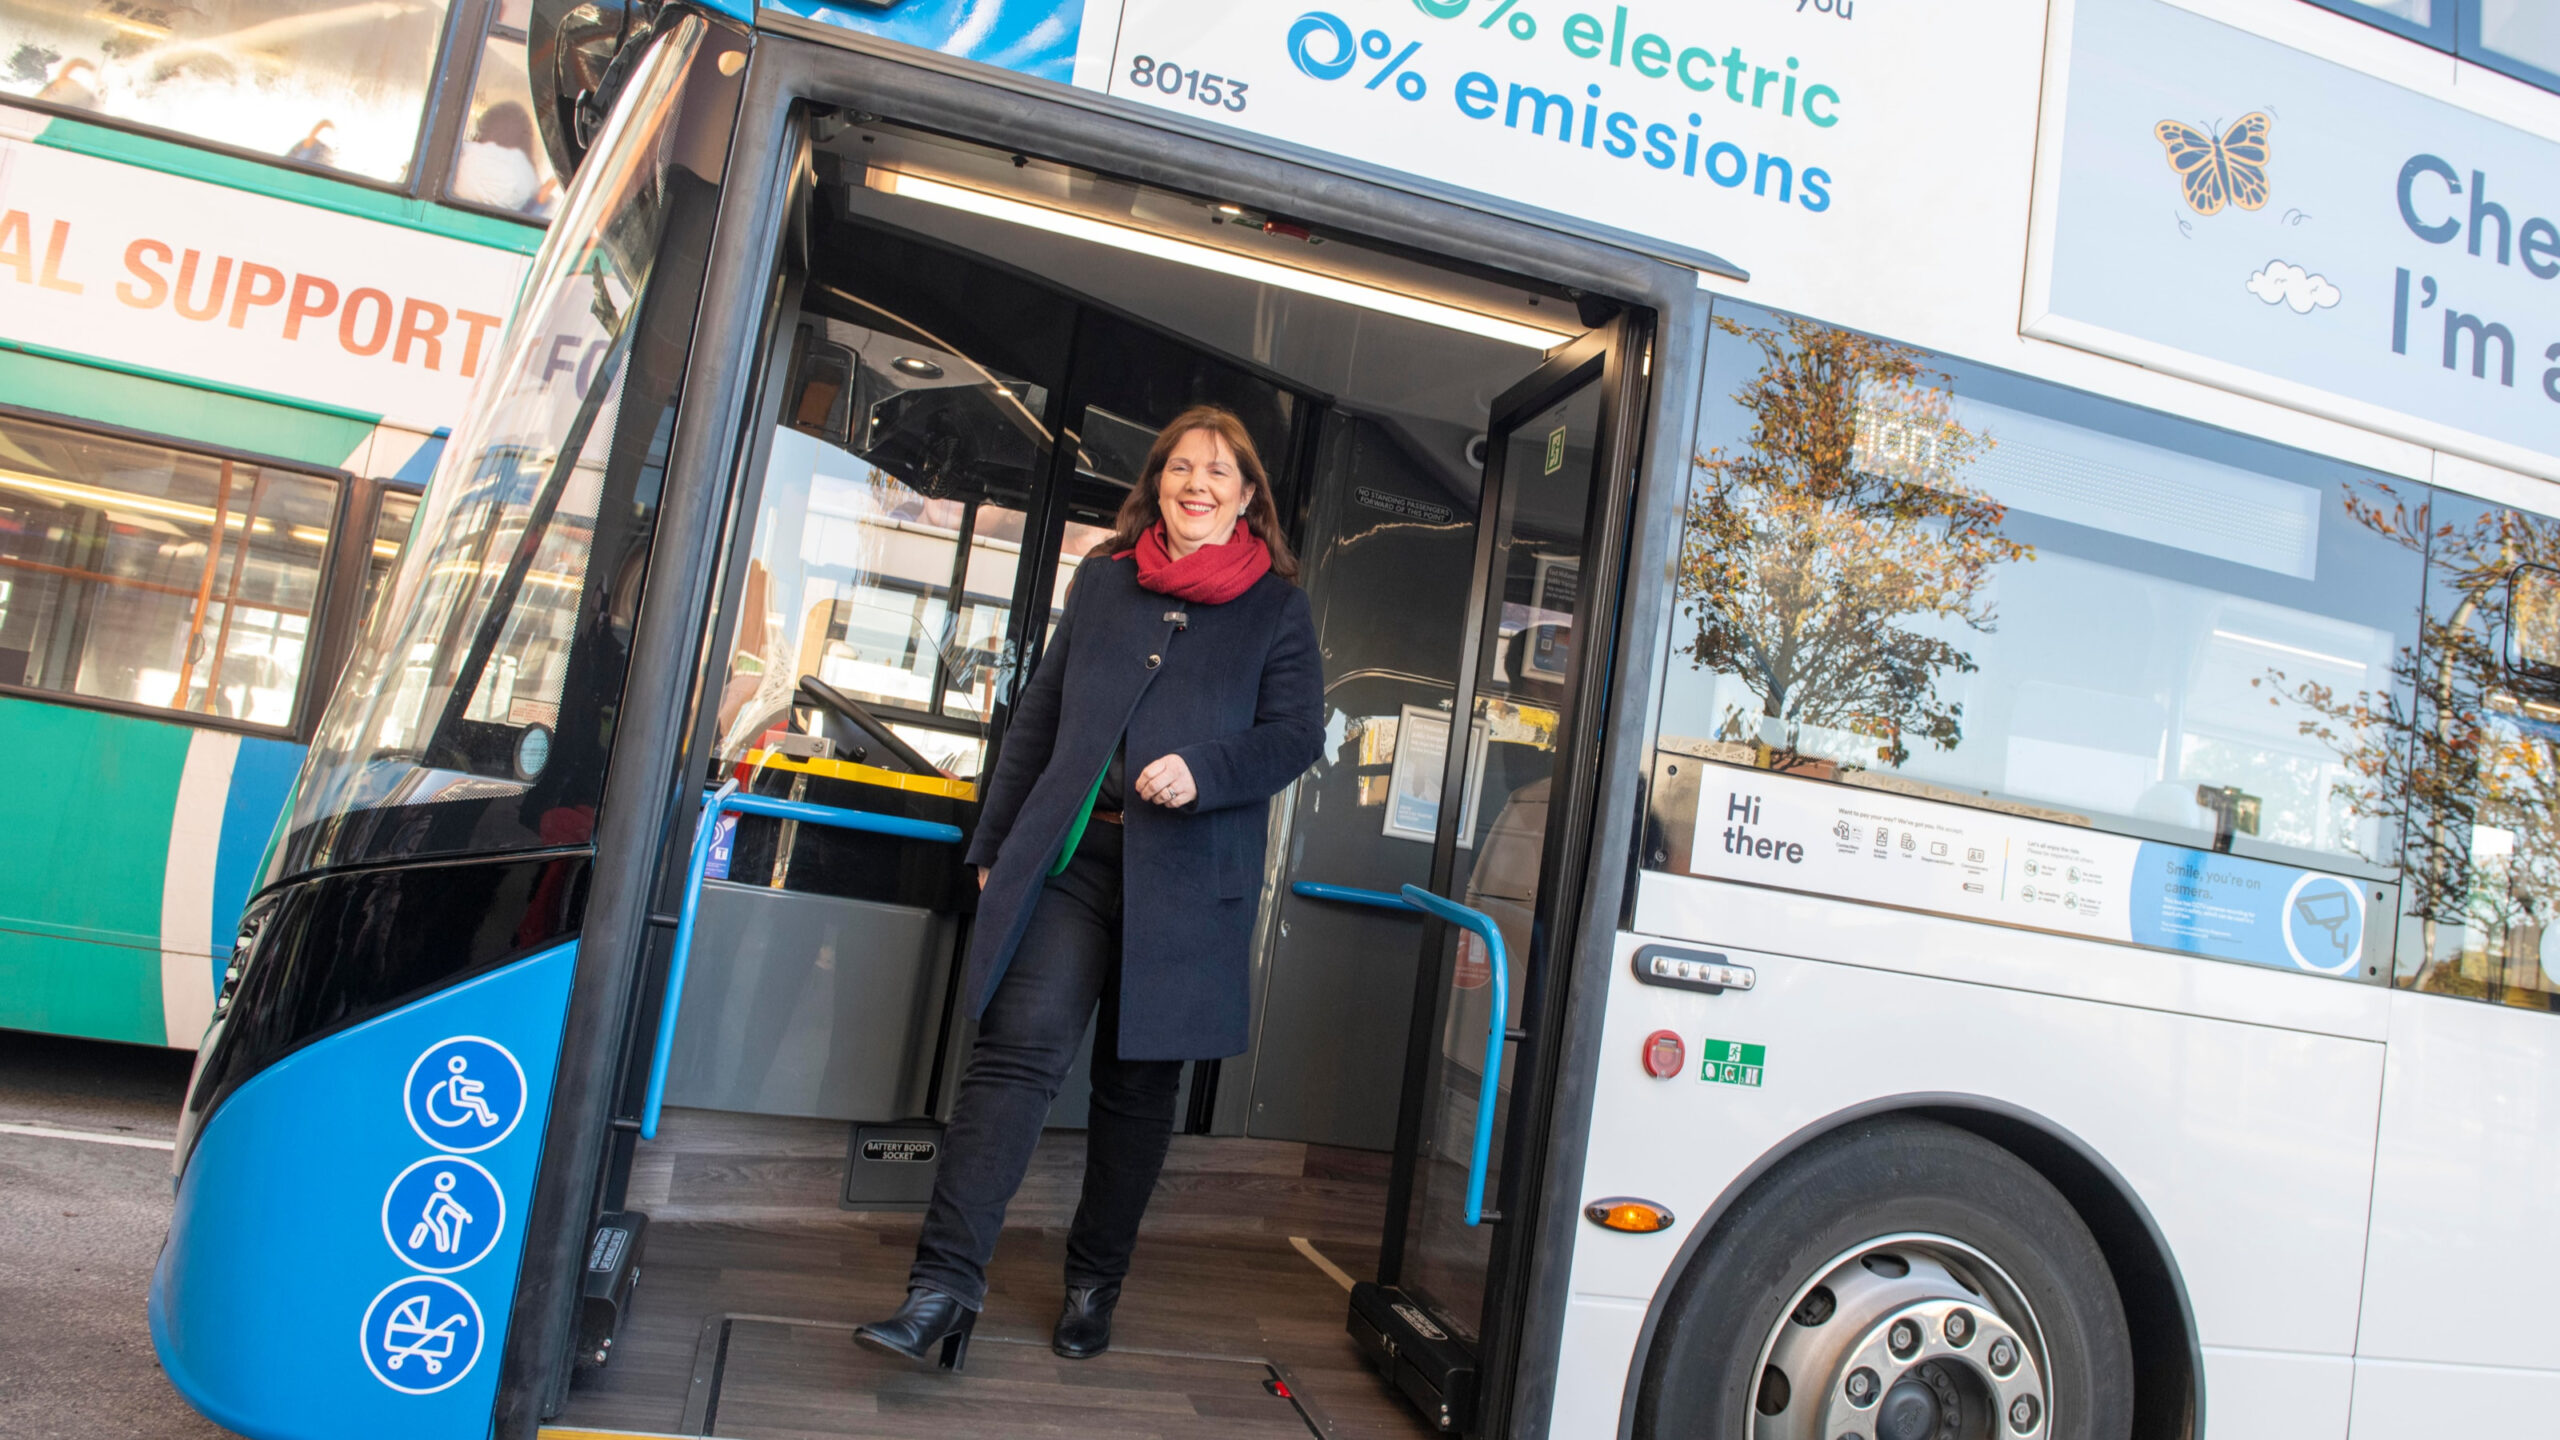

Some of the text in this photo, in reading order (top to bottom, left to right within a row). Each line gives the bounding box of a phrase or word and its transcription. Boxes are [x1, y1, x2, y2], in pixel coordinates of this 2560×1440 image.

[1562, 5, 1842, 130] electric
[1130, 55, 1249, 113] 80153
[1287, 11, 1832, 213] 0% emissions
[115, 238, 502, 379] SUPPORT
[1358, 488, 1450, 516] NO STANDING PASSENGERS
[1360, 497, 1394, 510] FORWARD
[1407, 508, 1422, 517] THIS
[1423, 512, 1446, 521] POINT
[1727, 792, 1761, 825] Hi
[1723, 825, 1804, 864] there
[2164, 881, 2213, 900] camera.
[2166, 861, 2261, 890] Smile, you're on
[868, 1142, 932, 1152] BATTERY BOOST
[882, 1152, 914, 1160] SOCKET
